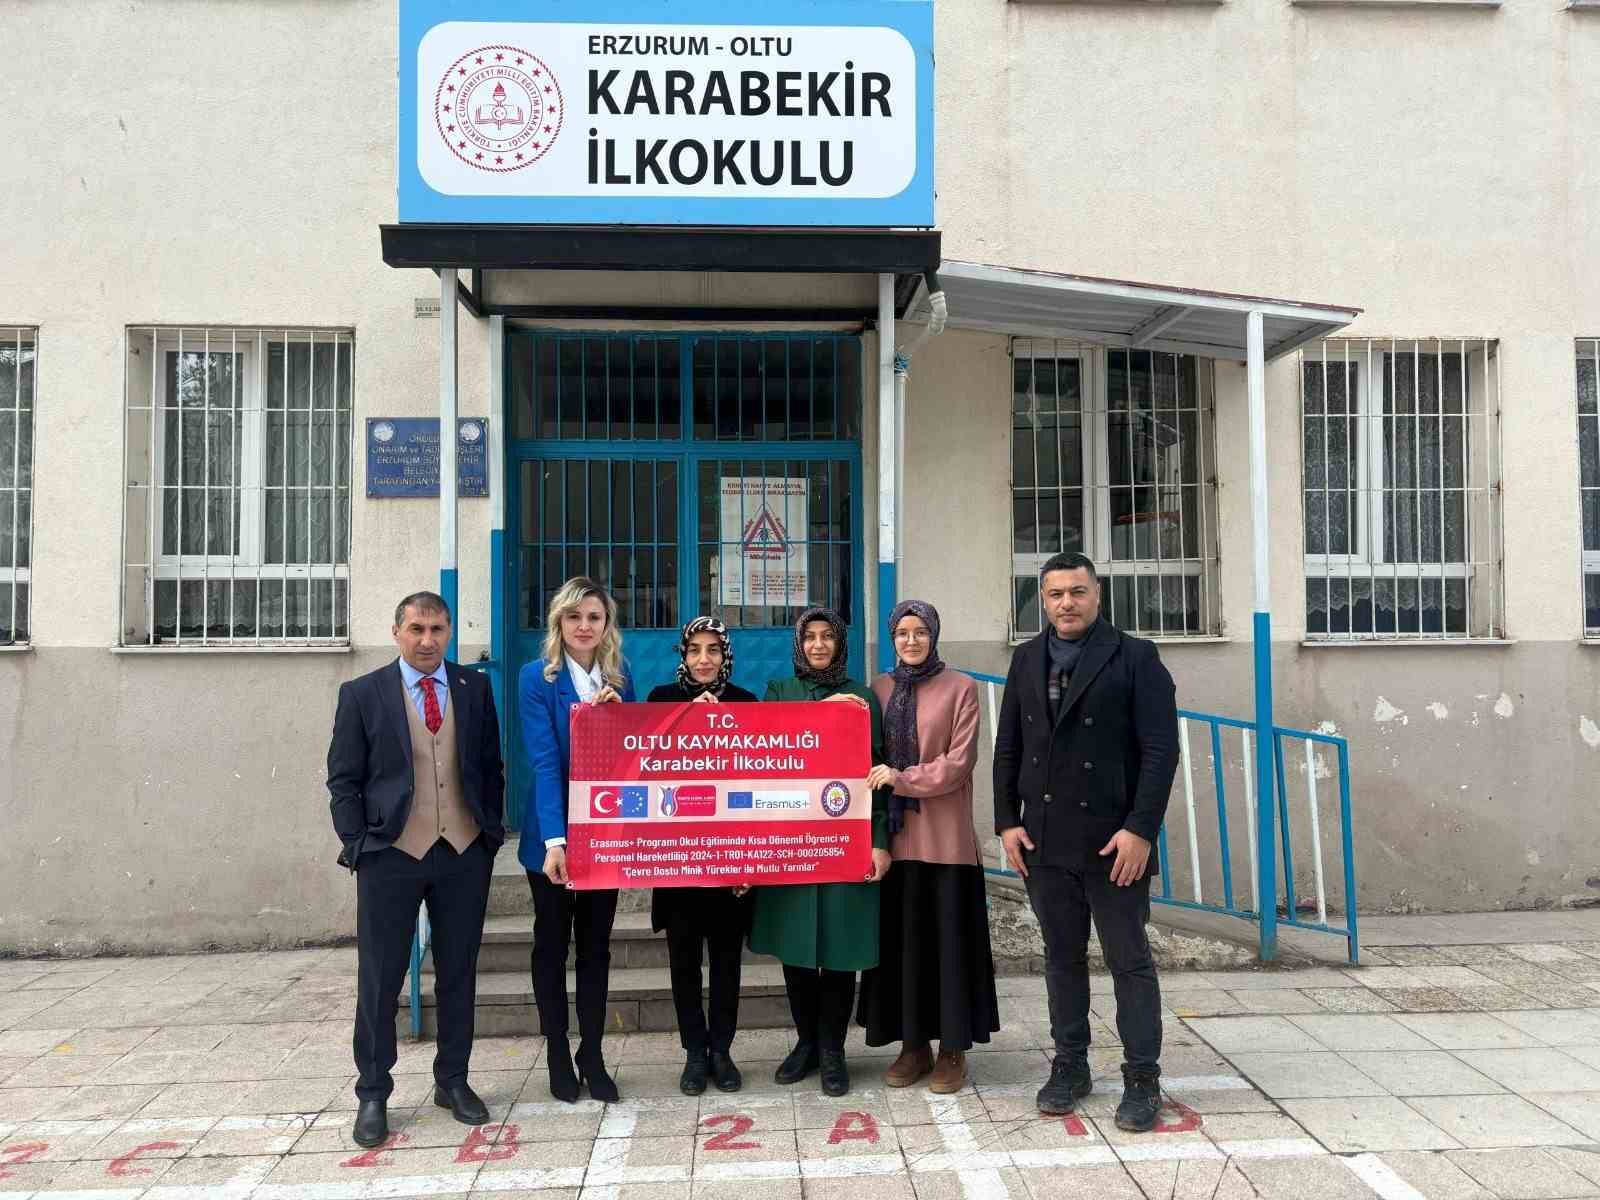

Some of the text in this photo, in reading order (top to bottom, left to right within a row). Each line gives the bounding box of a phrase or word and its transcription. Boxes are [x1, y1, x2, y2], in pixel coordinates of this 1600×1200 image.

[588, 35, 709, 55] ERZURUM
[730, 36, 792, 56] OLTU
[588, 60, 892, 117] KARABEKİR
[588, 127, 853, 186] İLKOKULU
[706, 713, 739, 728] T.C.
[623, 731, 819, 750] OLTU KAYMAKAMLIĞI
[640, 752, 804, 771] Karabekir İlkokulu
[755, 799, 811, 809] Erasmus+
[590, 838, 634, 848] Erasmus+
[637, 837, 677, 849] Programı
[680, 836, 698, 846] Okul
[701, 835, 745, 847] Eğitiminde
[748, 836, 767, 845] Kısa
[805, 832, 838, 845] Öğrenci
[840, 835, 850, 843] ve
[595, 852, 634, 863] Personel
[654, 866, 679, 876] Dostu
[681, 865, 703, 876] Minik
[706, 864, 741, 876] Yürekler
[744, 863, 754, 874] ile
[757, 863, 779, 874] Mutlu
[703, 1111, 880, 1150] 2 A
[453, 1123, 520, 1163] B
[105, 1140, 177, 1176] C
